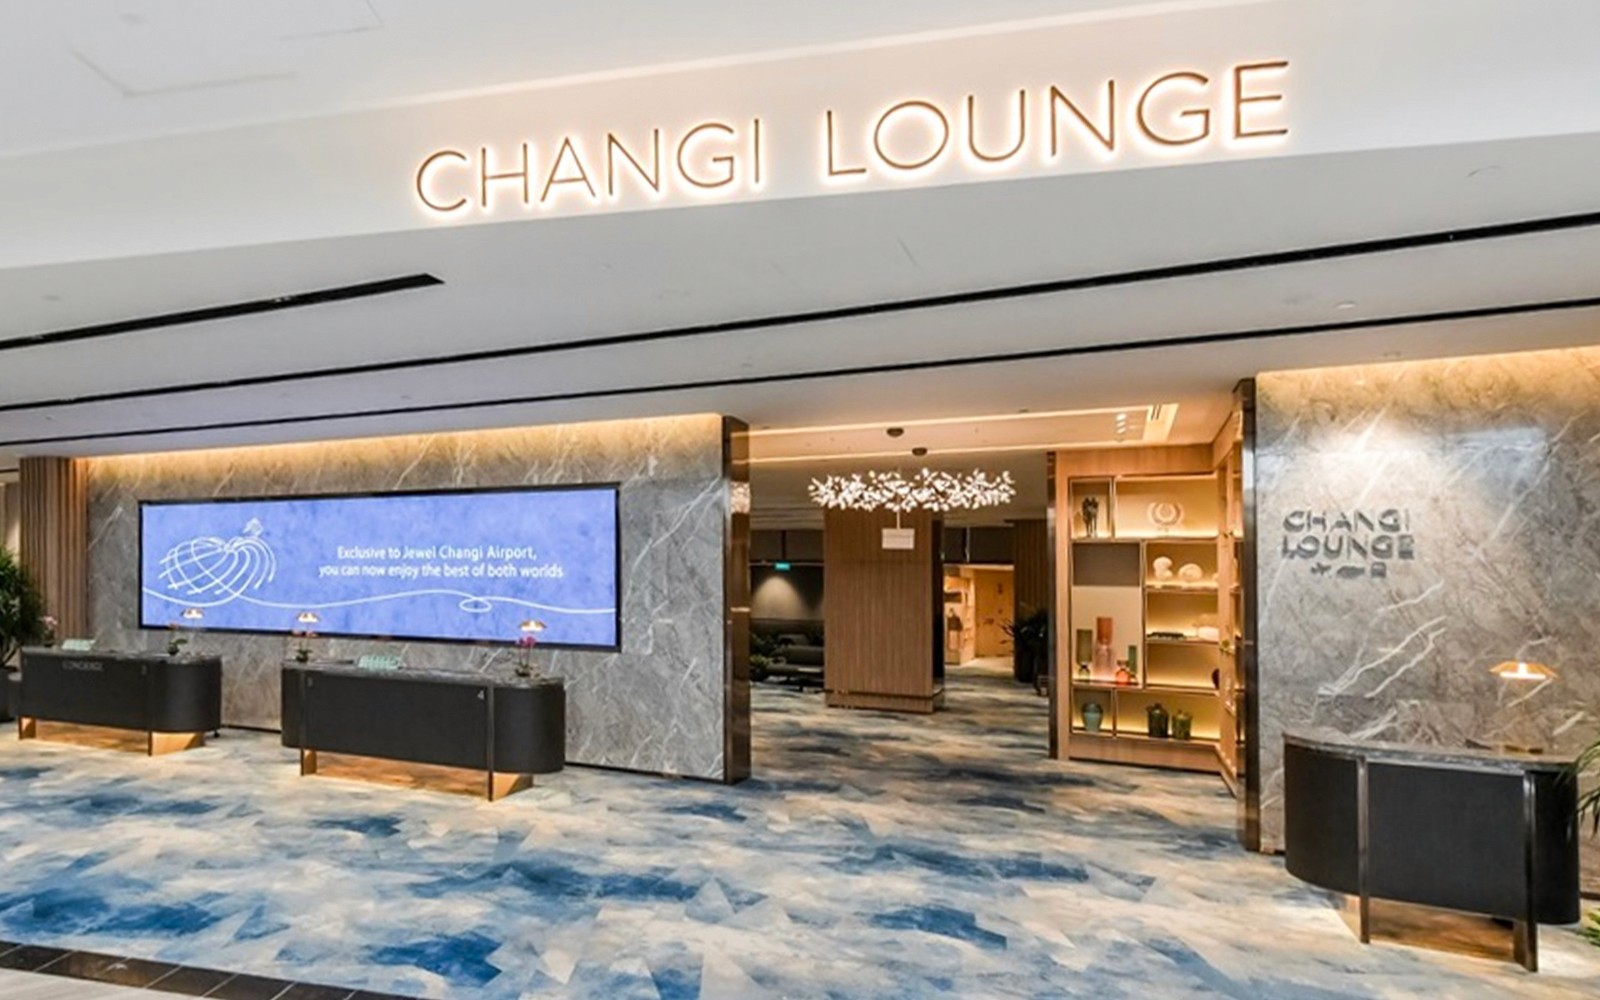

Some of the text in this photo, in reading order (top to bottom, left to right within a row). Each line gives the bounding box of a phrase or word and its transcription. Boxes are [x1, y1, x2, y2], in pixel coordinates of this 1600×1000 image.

[415, 60, 1290, 212] CHANGI LOUNGE
[1283, 509, 1411, 533] CHANGI
[337, 545, 538, 562] Exclusive to Jewel Changi Airport,
[1282, 534, 1415, 560] LOUNGE
[318, 562, 564, 581] you can now enjoy the best of both worlds
